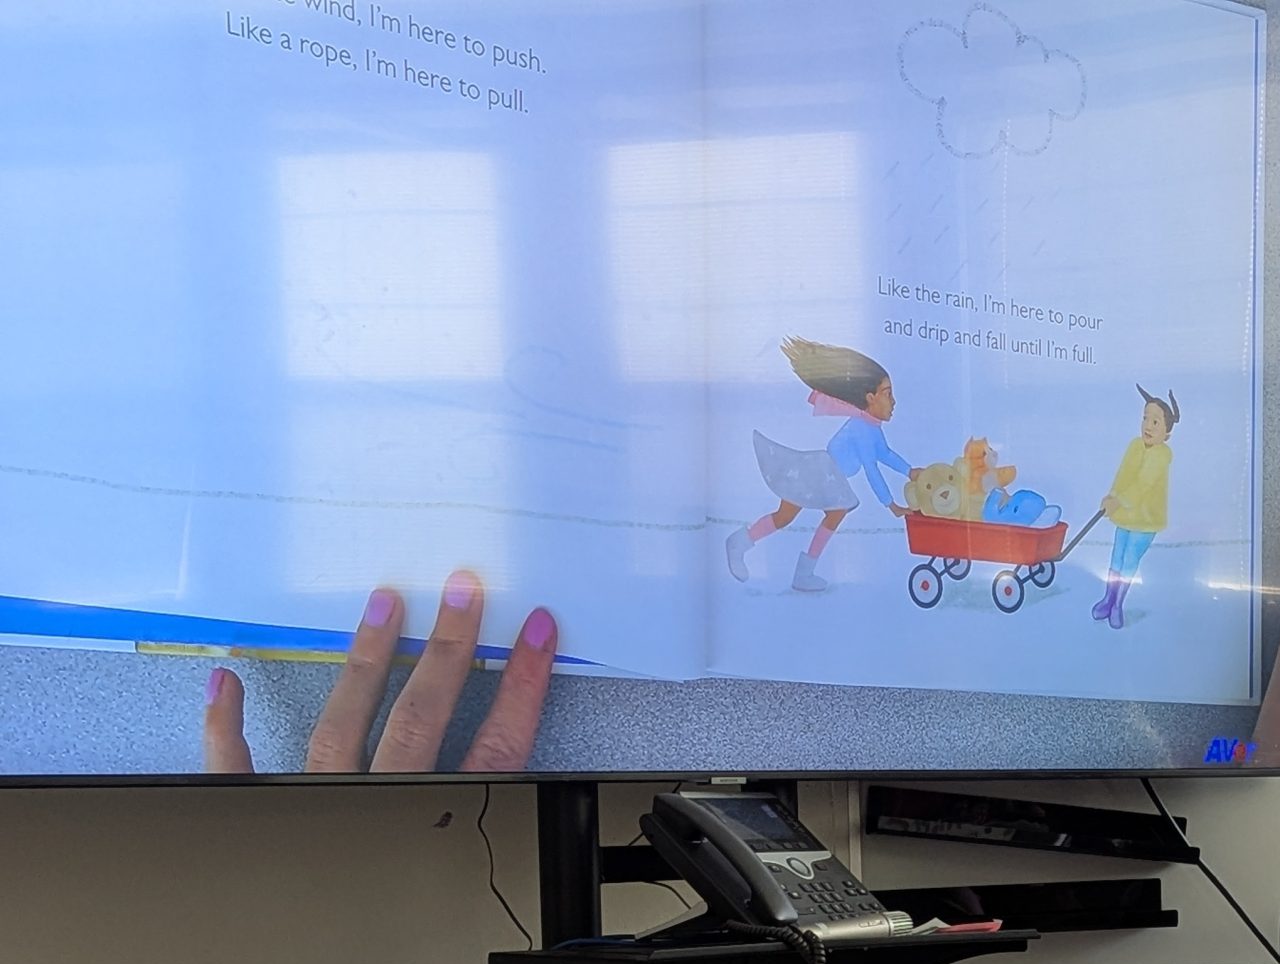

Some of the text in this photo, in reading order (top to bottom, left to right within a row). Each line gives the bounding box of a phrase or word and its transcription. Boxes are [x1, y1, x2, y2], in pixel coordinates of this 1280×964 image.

[226, 11, 529, 114] Like a rope, I'm here to pull.
[369, 4, 401, 34] I'm
[409, 15, 457, 50] here
[463, 35, 486, 57] to
[493, 43, 547, 74] push.
[878, 276, 1104, 331] Like the rain, I'm here to pour
[884, 318, 1097, 365] and drip and fall until I'm full.
